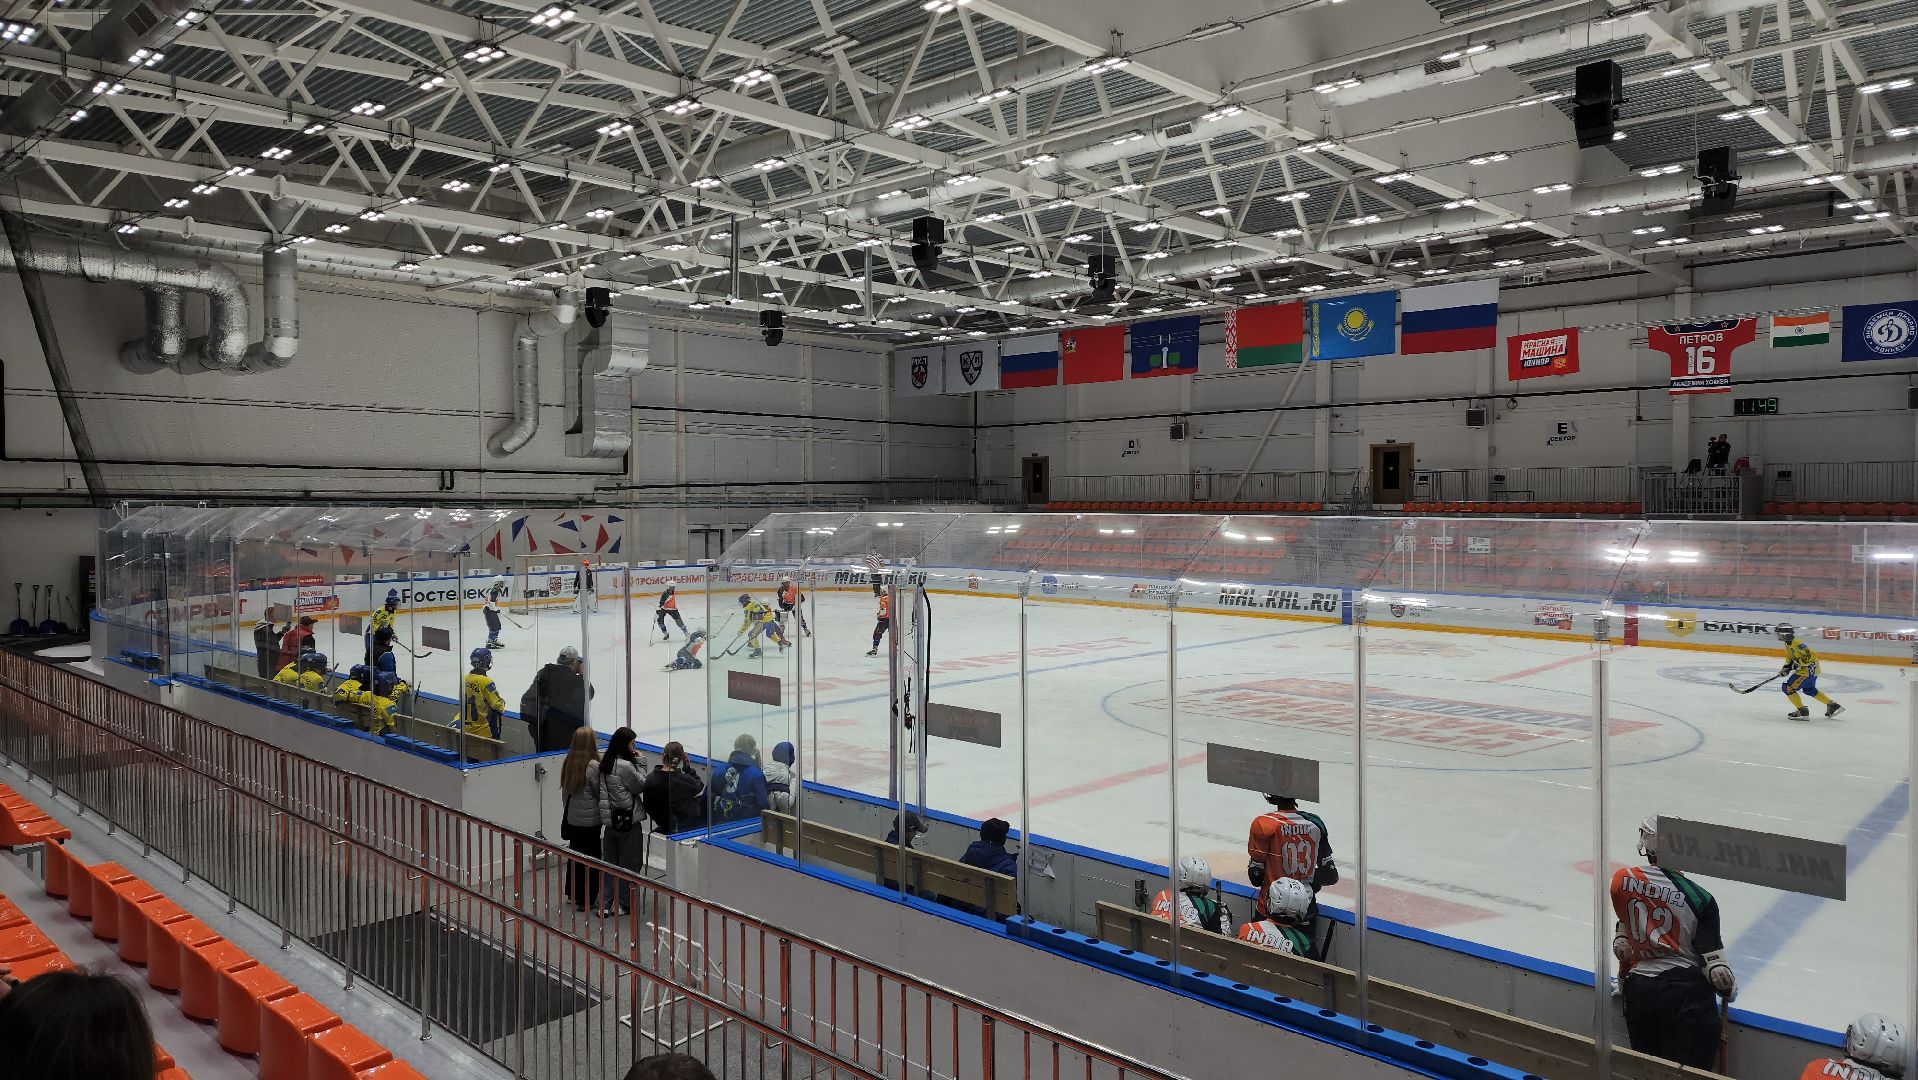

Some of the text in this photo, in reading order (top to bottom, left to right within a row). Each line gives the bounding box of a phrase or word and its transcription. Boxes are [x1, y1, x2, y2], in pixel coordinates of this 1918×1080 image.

[1523, 338, 1555, 349] КРАСНАЯ
[1679, 333, 1724, 345] ПЕТРОВ
[1522, 344, 1564, 358] МАШИНА
[1685, 345, 1716, 375] 16
[1523, 358, 1550, 368] ЮНИОР
[401, 586, 509, 604] Ростеекм
[1218, 587, 1339, 612] MHL.KHL.RU
[1280, 823, 1313, 836] INDIA
[1281, 839, 1313, 876] 03
[1622, 876, 1686, 908] INDIA
[1155, 900, 1199, 921] INIA
[1627, 898, 1673, 950] 02
[1246, 928, 1294, 953] INDIA
